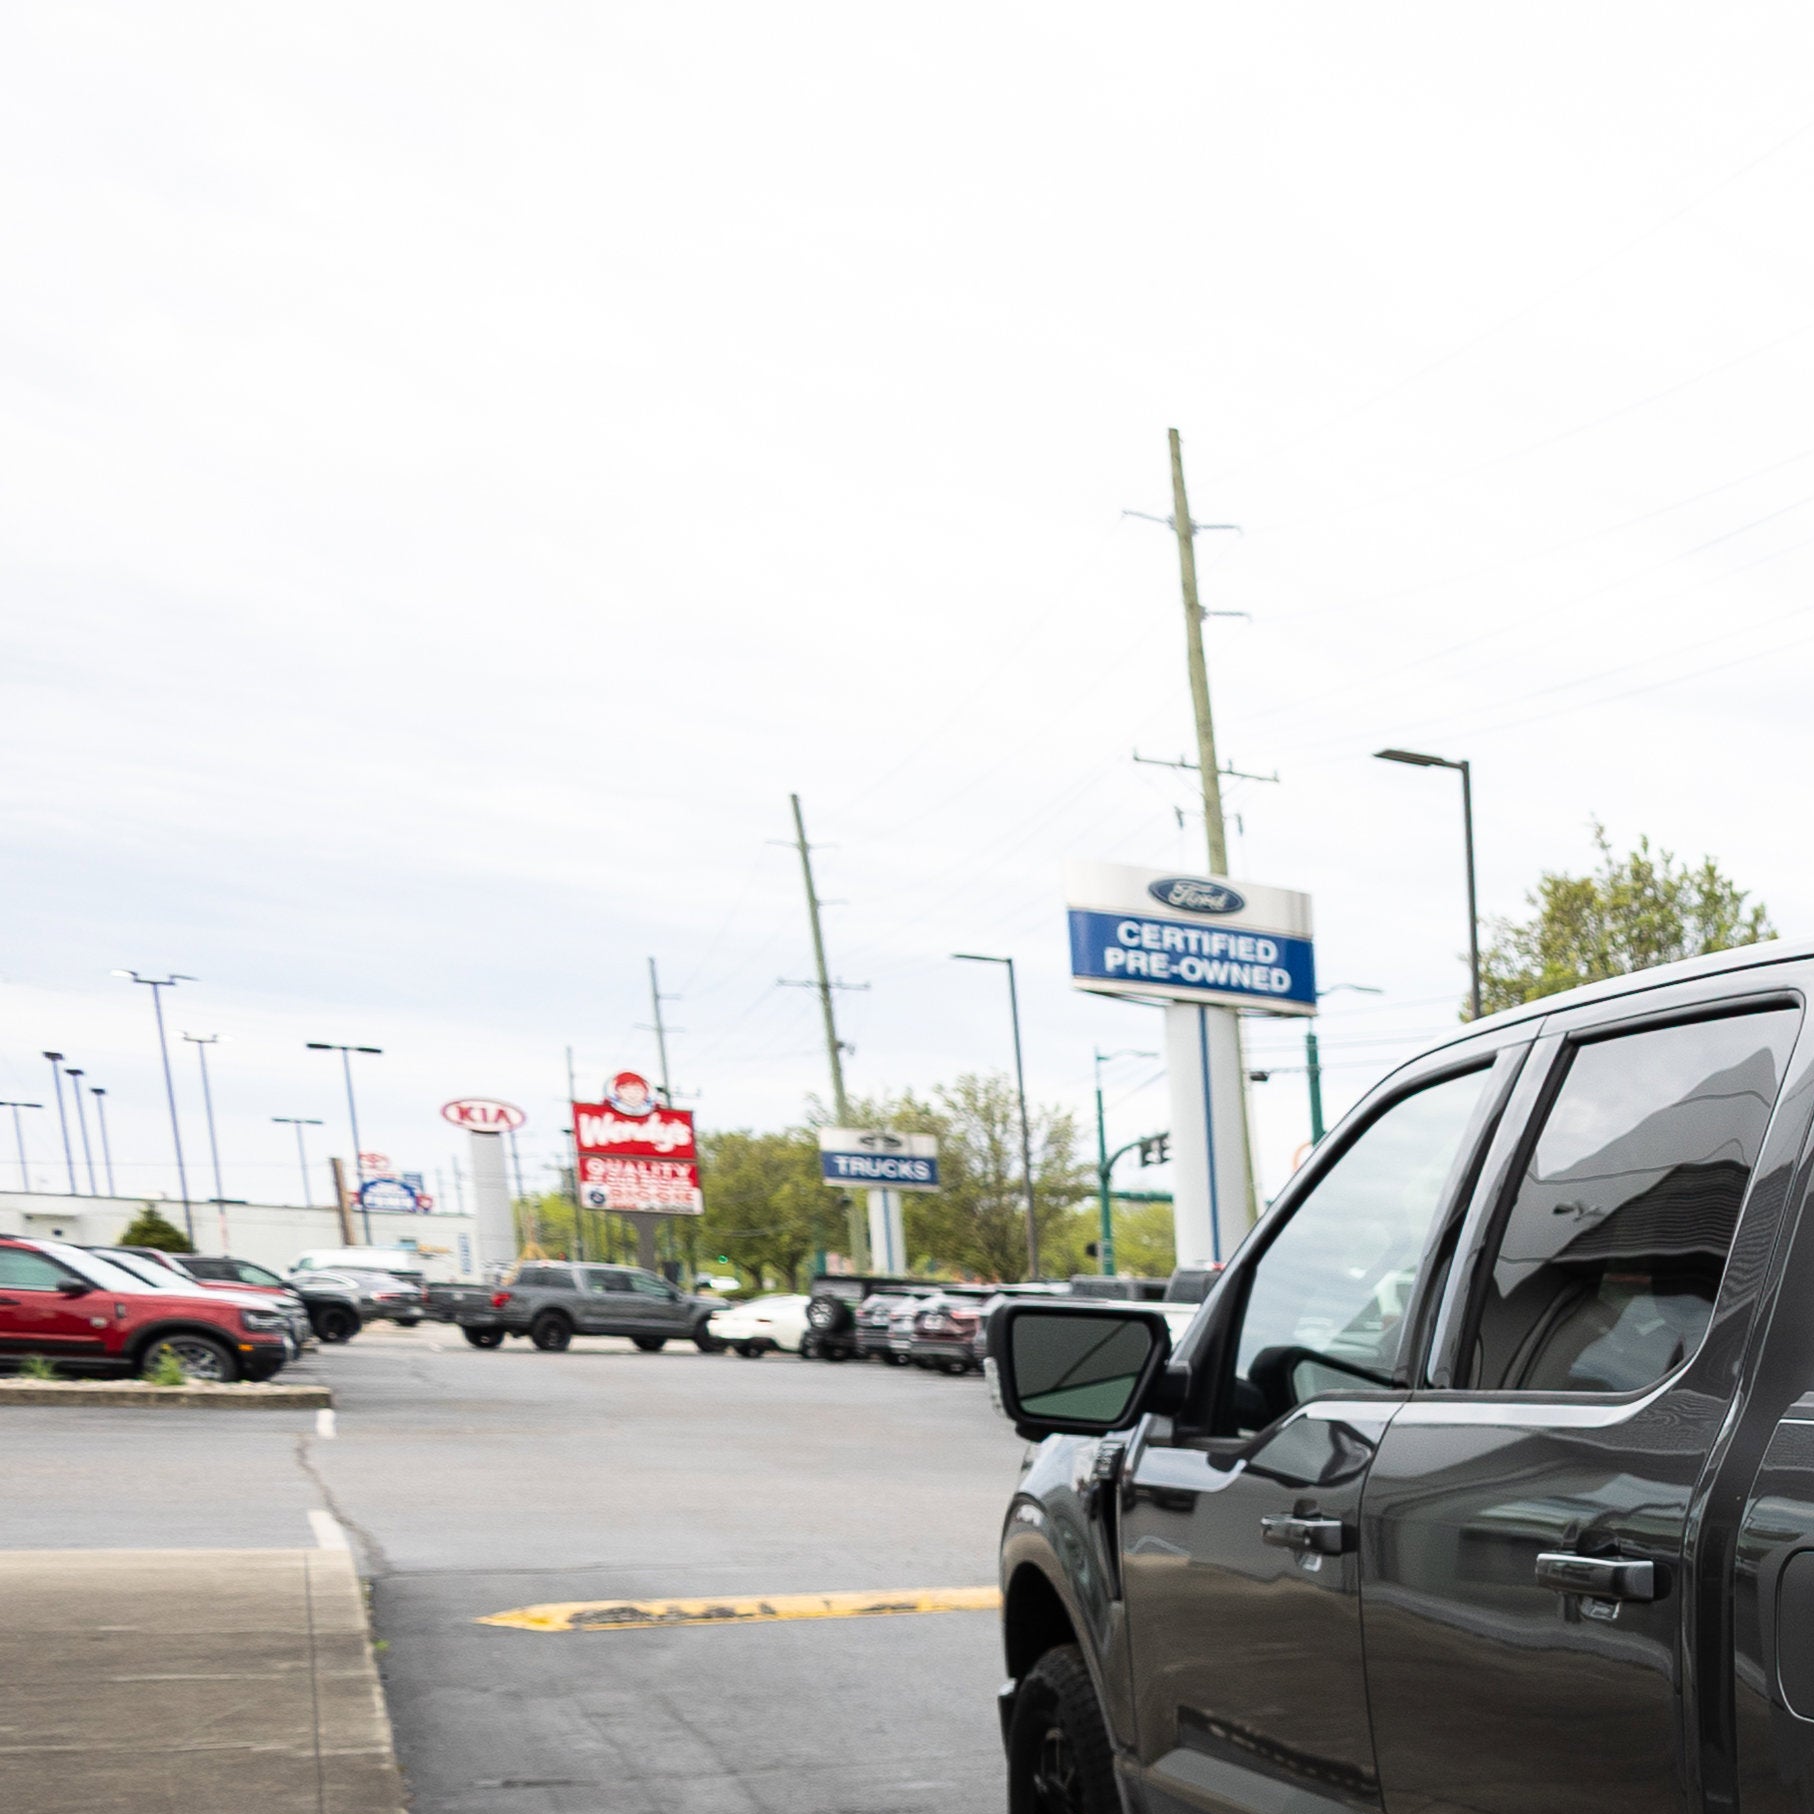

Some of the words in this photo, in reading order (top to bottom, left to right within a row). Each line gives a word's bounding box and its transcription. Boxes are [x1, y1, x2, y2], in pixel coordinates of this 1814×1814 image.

[1167, 880, 1232, 911] Ford
[1116, 920, 1279, 965] CERTIFIED
[1103, 946, 1292, 994] PRE-OWNED
[457, 1105, 513, 1125] KIA
[578, 1111, 693, 1153] Wendy's
[585, 1157, 692, 1180] QUALITY
[831, 1154, 932, 1181] TRUCKS
